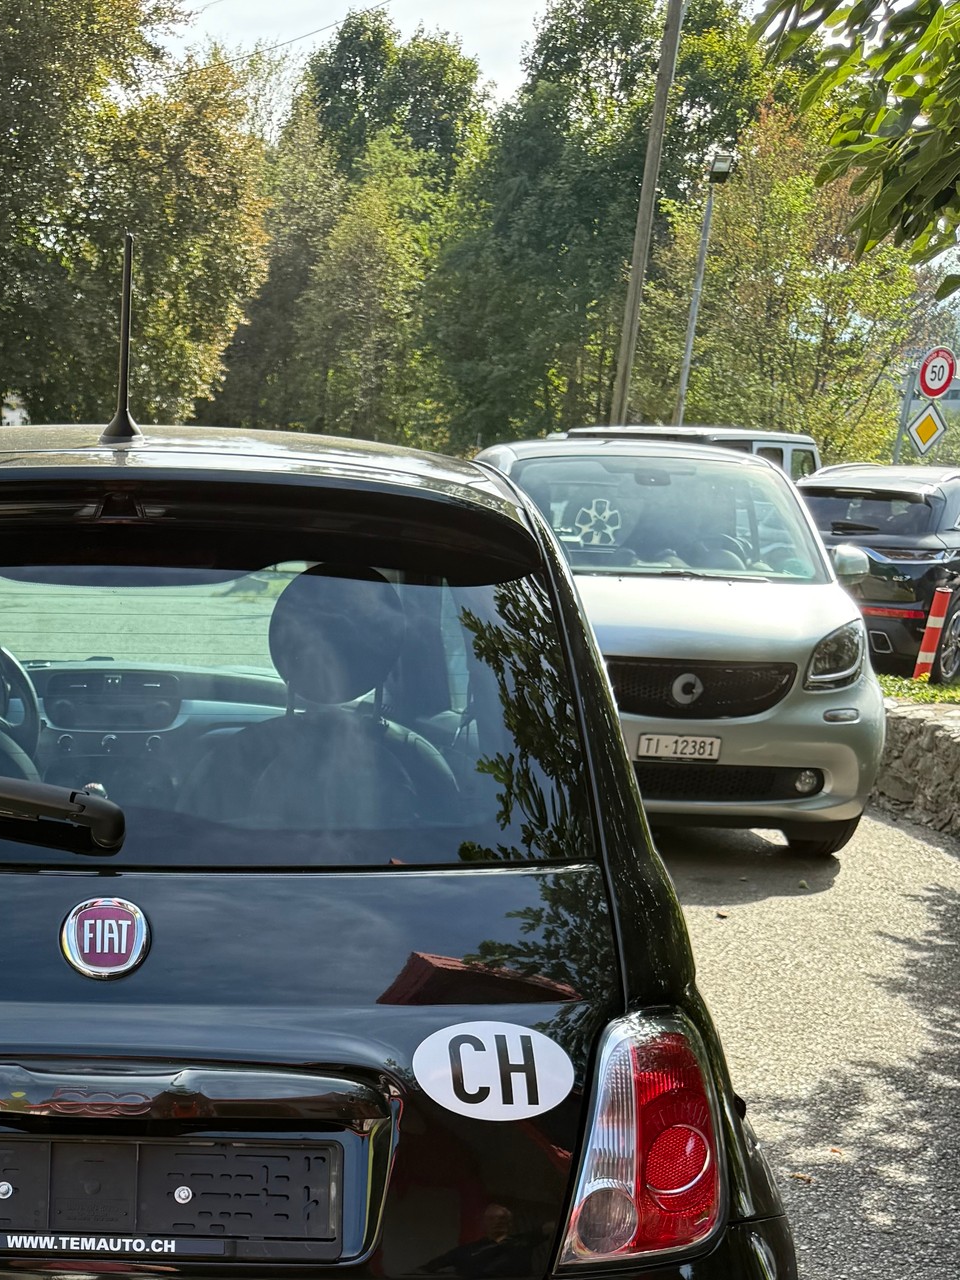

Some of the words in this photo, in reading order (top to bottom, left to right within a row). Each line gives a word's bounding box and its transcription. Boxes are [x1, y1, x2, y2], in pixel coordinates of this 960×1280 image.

[930, 364, 945, 382] 50
[672, 739, 714, 756] 12381
[83, 919, 132, 954] FIAT
[448, 1034, 540, 1105] CH
[50, 1085, 153, 1116] 500
[6, 1235, 176, 1253] WWW.TEMAUTO.CH
